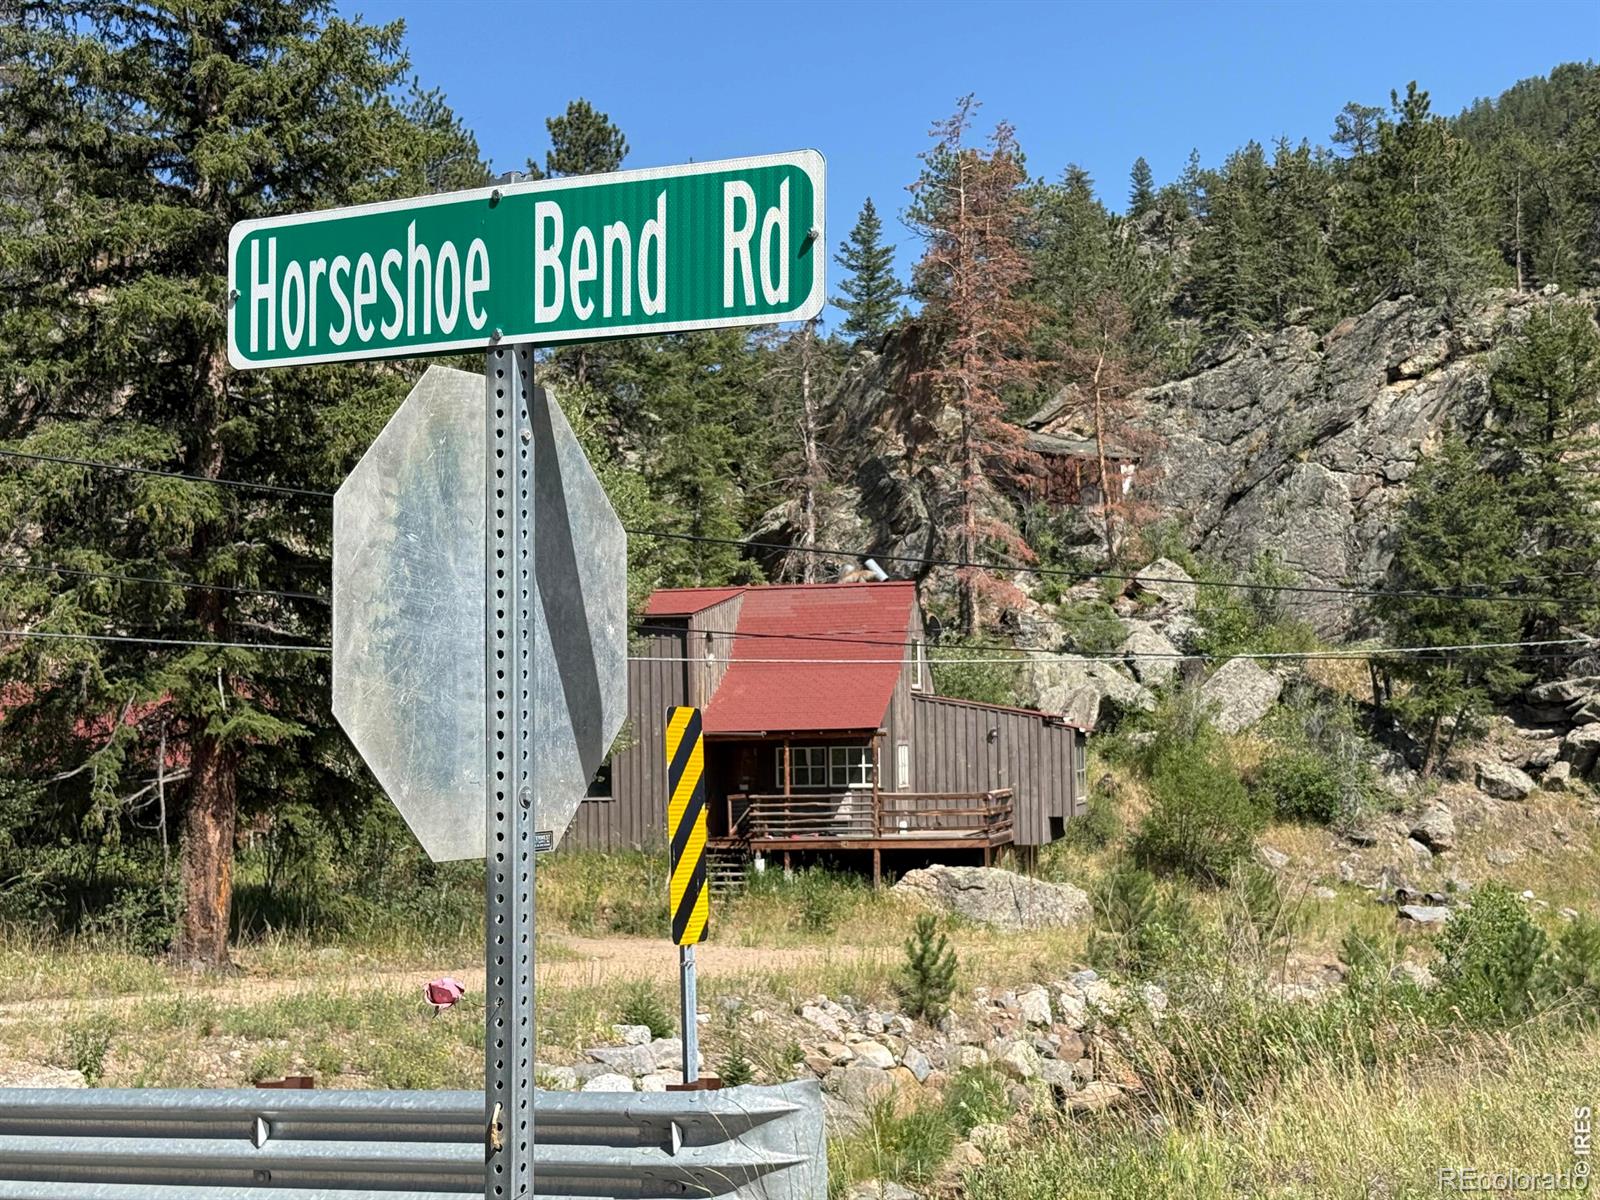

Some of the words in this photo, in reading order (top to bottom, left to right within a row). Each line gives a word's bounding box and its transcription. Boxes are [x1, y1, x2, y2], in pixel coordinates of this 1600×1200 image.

[250, 219, 490, 353] Horseshoe
[534, 189, 667, 324] Bend
[723, 175, 790, 309] Rd
